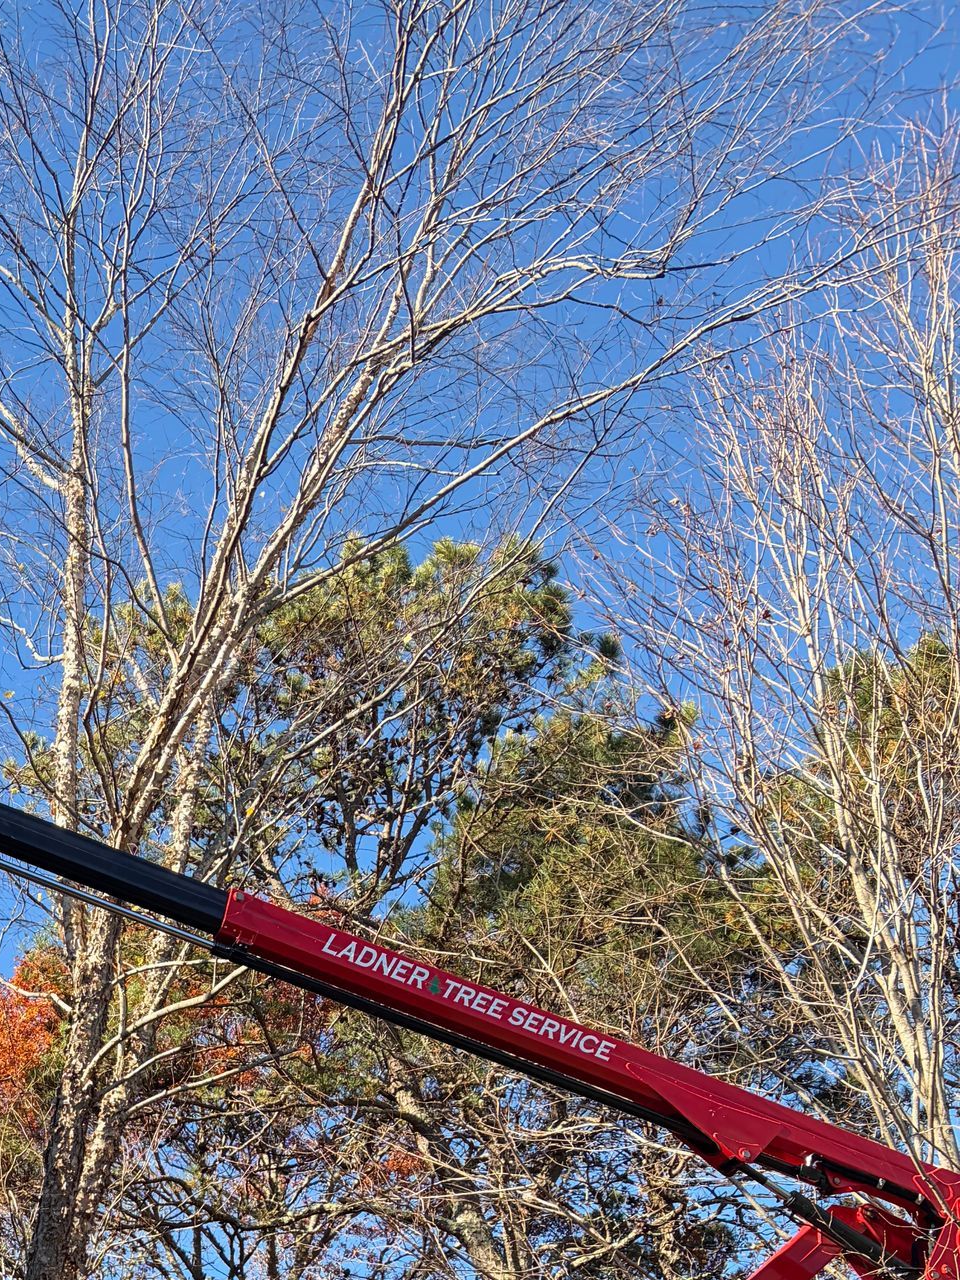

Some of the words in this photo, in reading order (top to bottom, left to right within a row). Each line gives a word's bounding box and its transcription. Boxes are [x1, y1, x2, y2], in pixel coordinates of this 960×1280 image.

[321, 933, 430, 990] LADNER
[442, 979, 510, 1019] TREE
[508, 1007, 617, 1062] SERVICE
